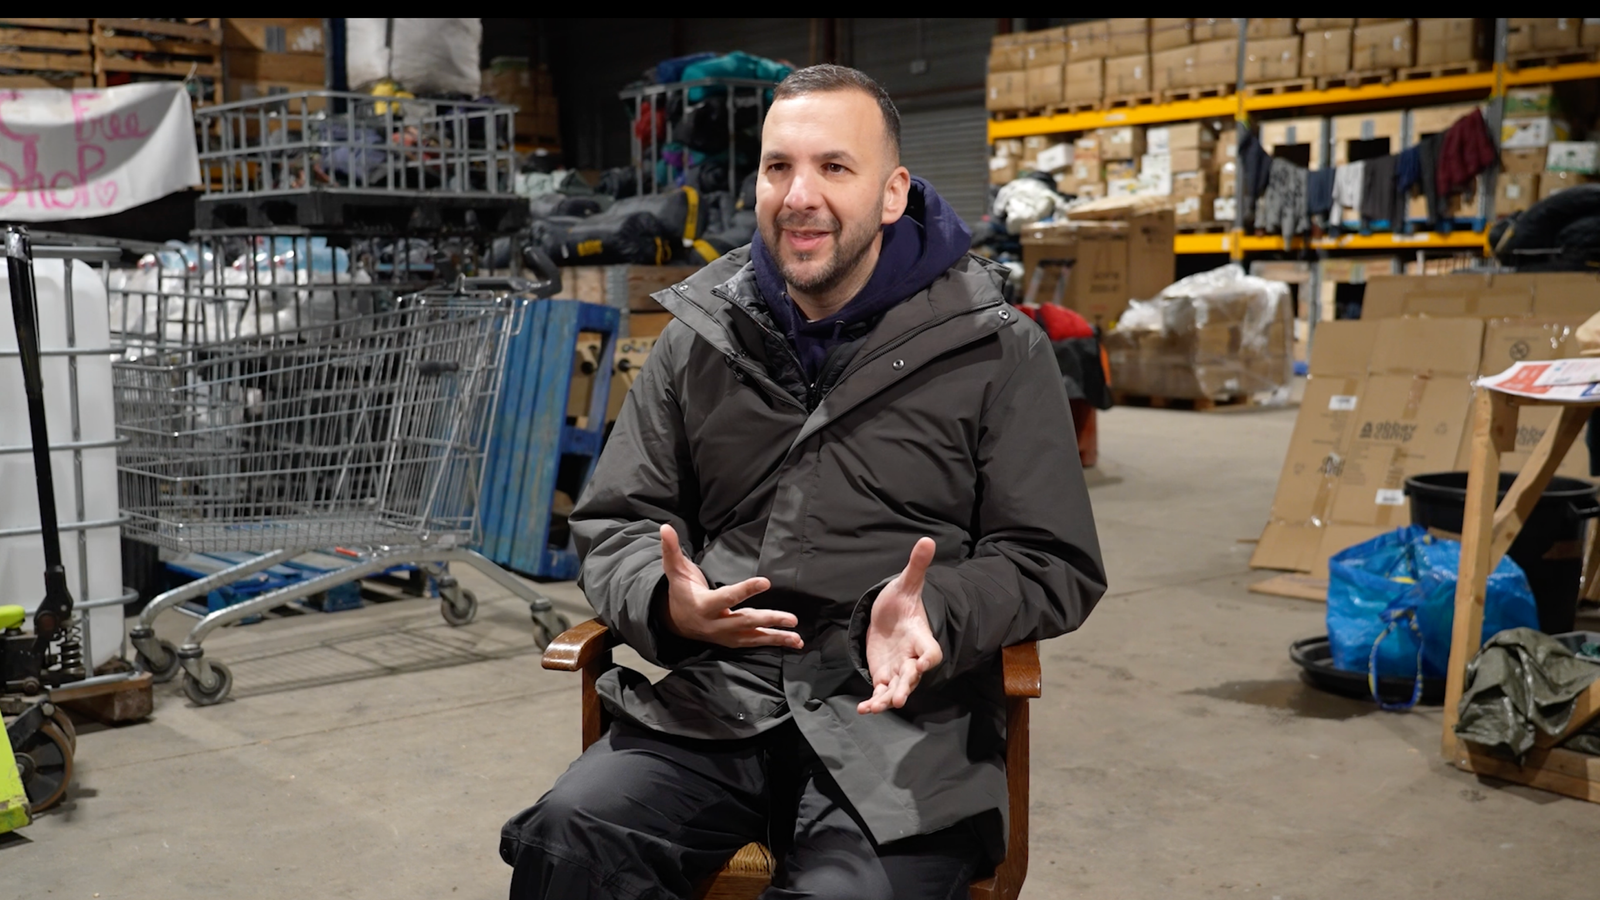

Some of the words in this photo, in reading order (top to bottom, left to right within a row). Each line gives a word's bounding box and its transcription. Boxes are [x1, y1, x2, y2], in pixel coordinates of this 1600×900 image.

[71, 92, 154, 142] Free
[1375, 419, 1418, 434] abbey
[1373, 431, 1413, 443] camp
